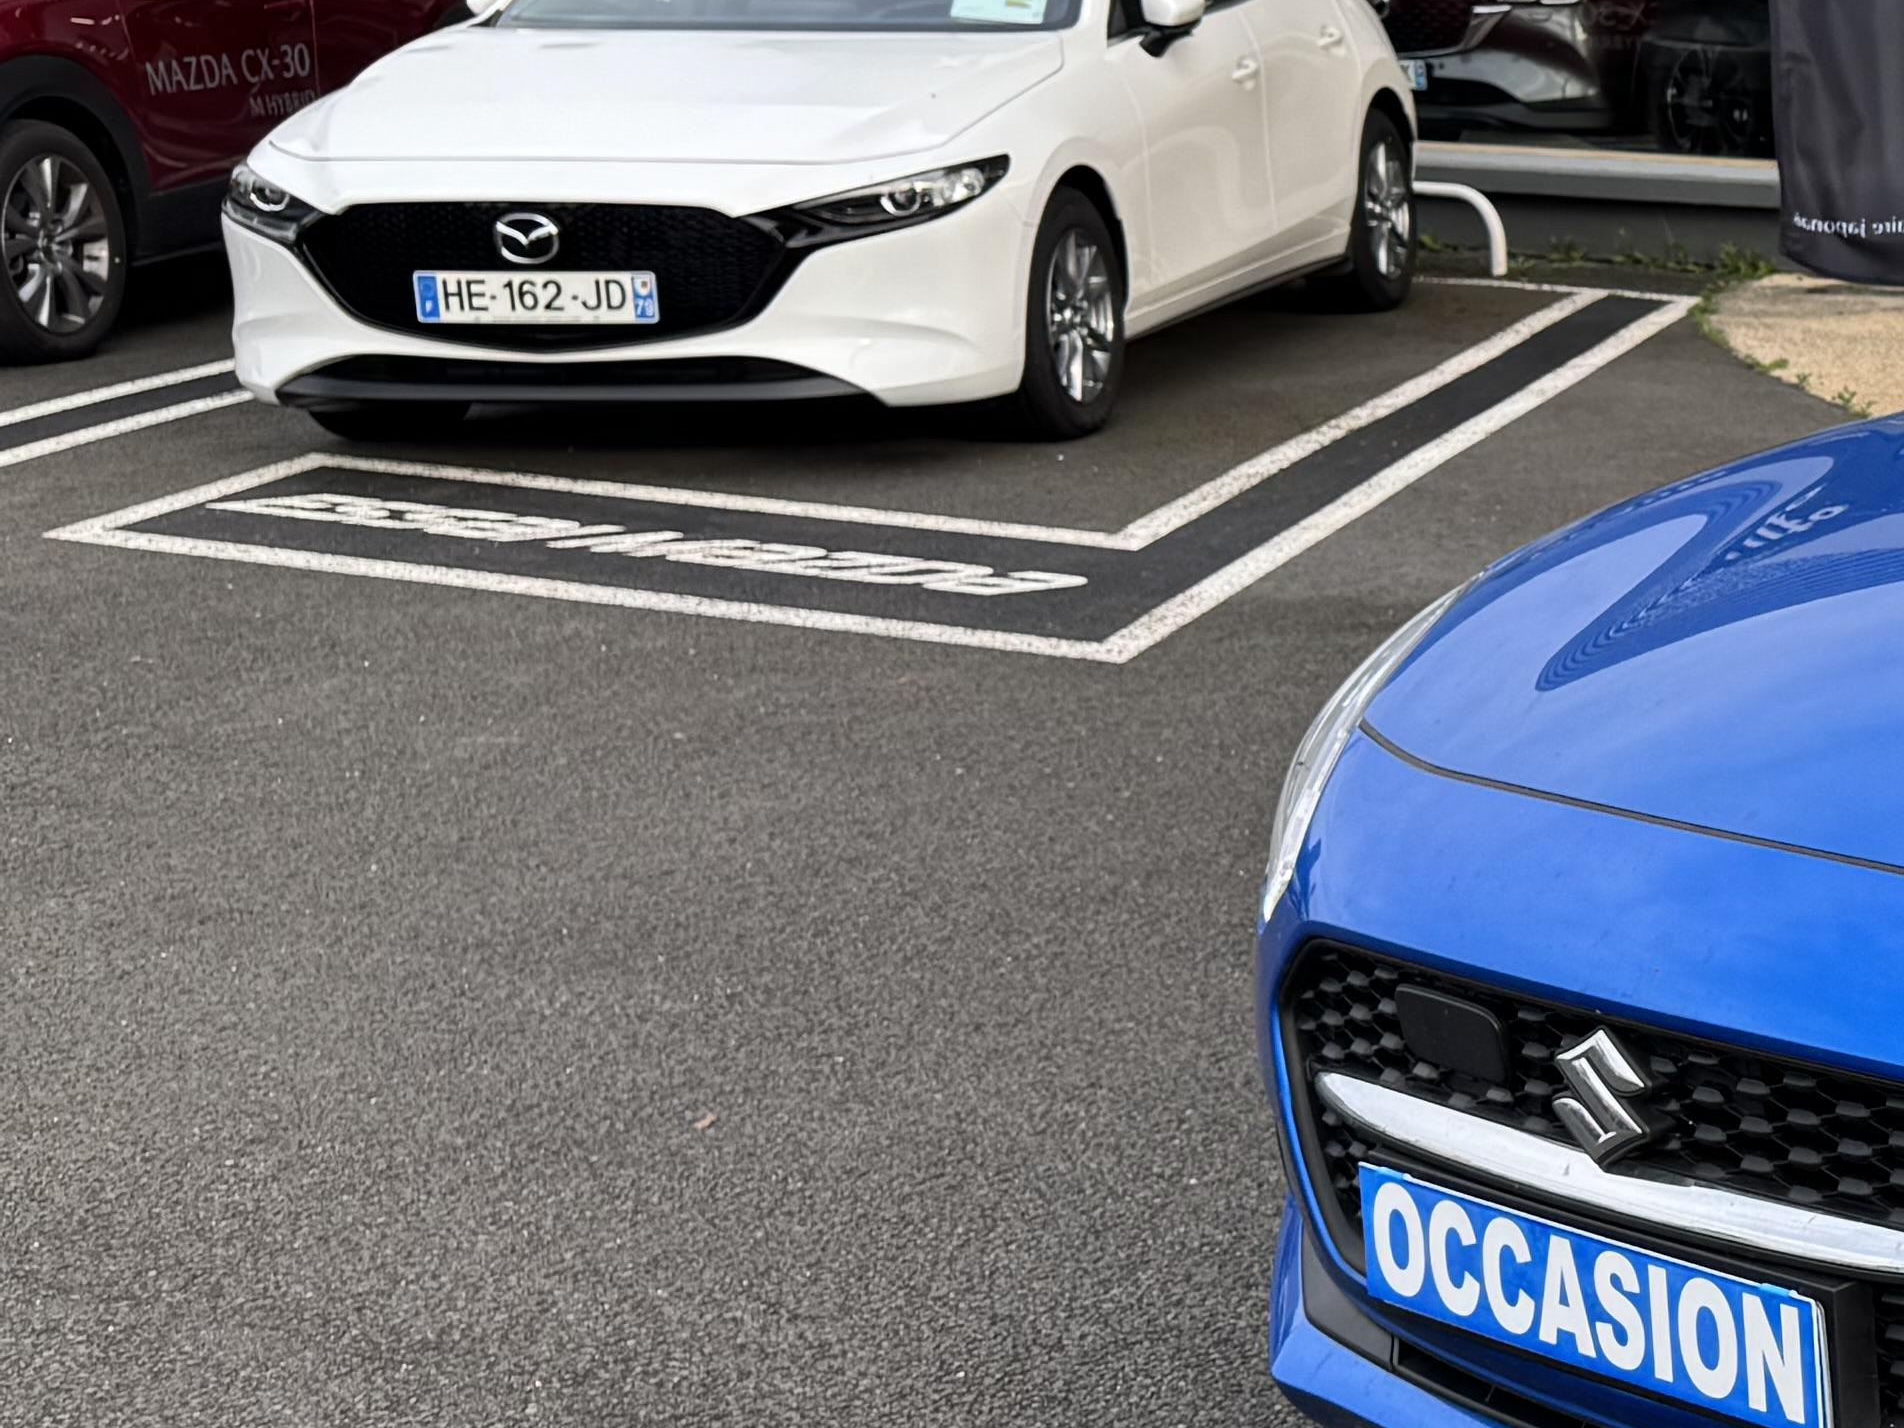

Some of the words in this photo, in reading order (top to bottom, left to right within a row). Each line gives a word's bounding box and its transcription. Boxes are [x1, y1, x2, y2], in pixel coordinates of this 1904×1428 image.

[144, 52, 239, 96] MAZDA
[241, 43, 311, 84] CX-30
[441, 278, 628, 313] HE-162-JD
[1372, 1179, 1807, 1425] OCCASION
